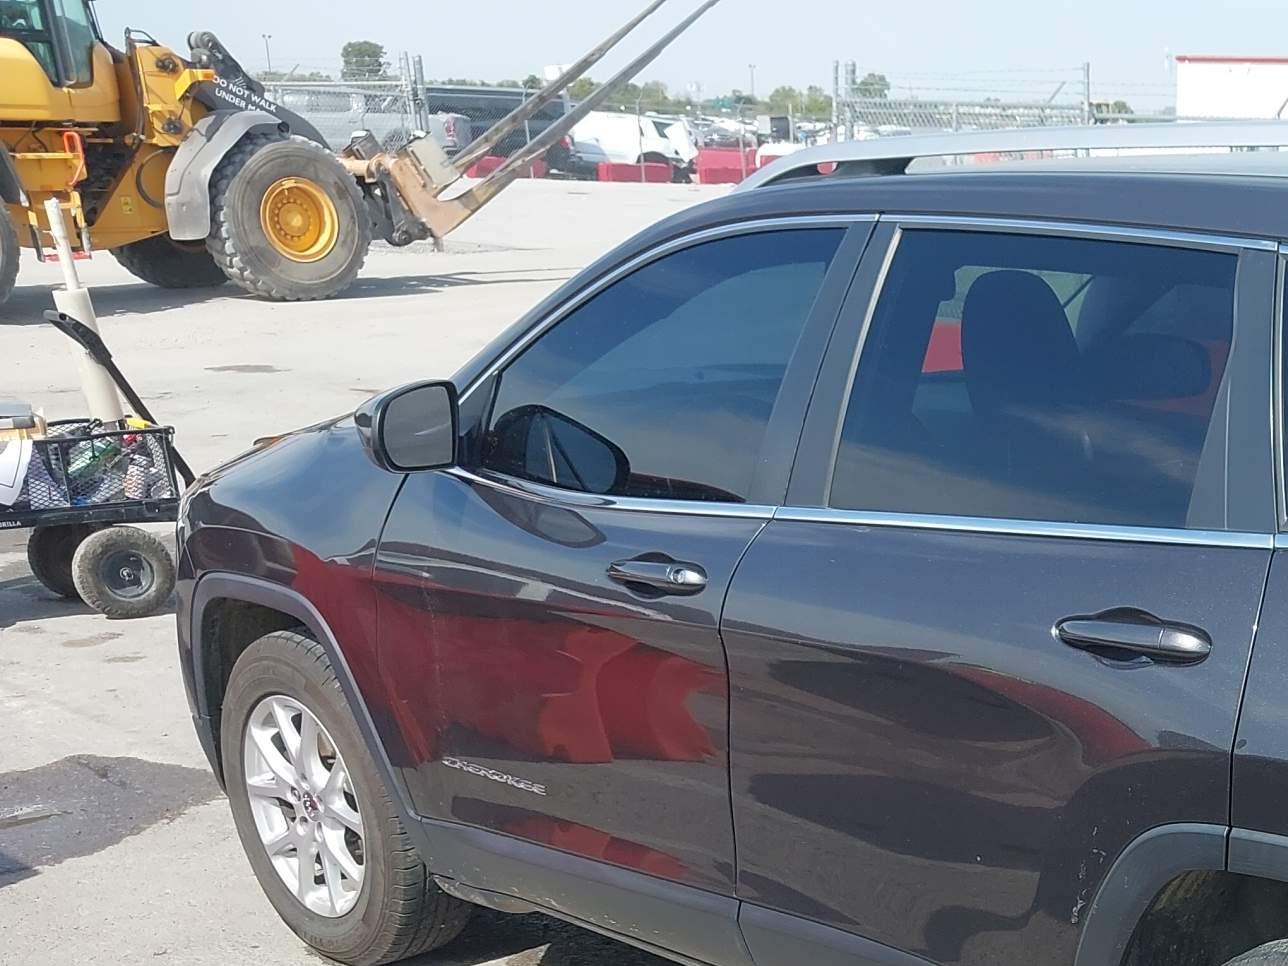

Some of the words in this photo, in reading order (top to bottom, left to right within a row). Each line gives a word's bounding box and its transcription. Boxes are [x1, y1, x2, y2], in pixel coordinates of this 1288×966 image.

[212, 75, 228, 87] DO
[228, 83, 250, 98] NOT
[250, 93, 277, 113] WALK
[215, 88, 246, 109] UNDER
[442, 756, 547, 796] CHEROKEE
